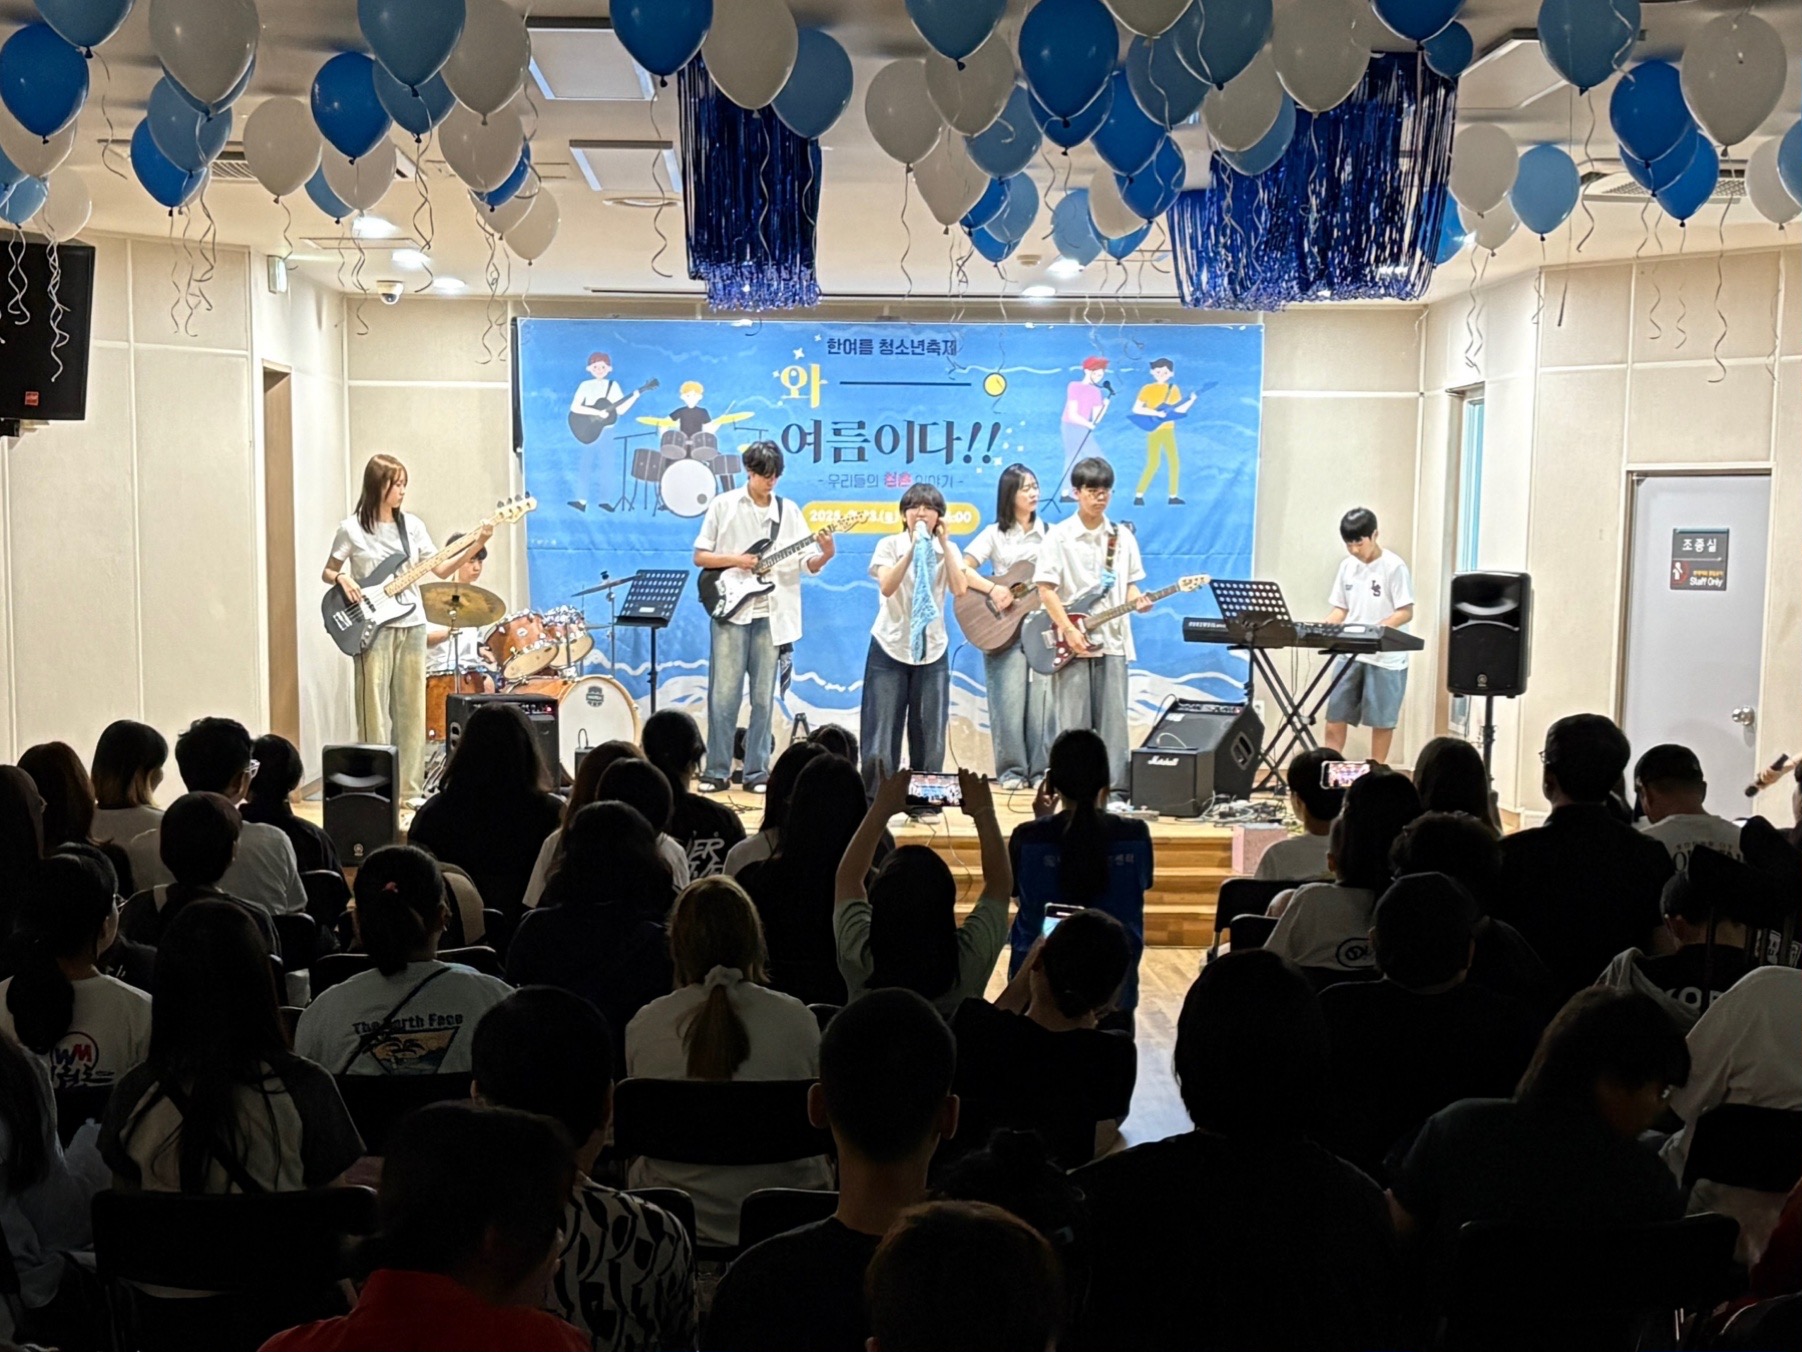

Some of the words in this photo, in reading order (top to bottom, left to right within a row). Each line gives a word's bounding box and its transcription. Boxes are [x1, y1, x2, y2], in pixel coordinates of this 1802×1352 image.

[826, 338, 874, 356] 한여름
[879, 338, 958, 357] 청소년축제
[780, 363, 829, 409] 와
[781, 418, 1001, 466] 여름이다!!
[828, 473, 879, 489] 우리들의
[428, 1013, 463, 1027] Face
